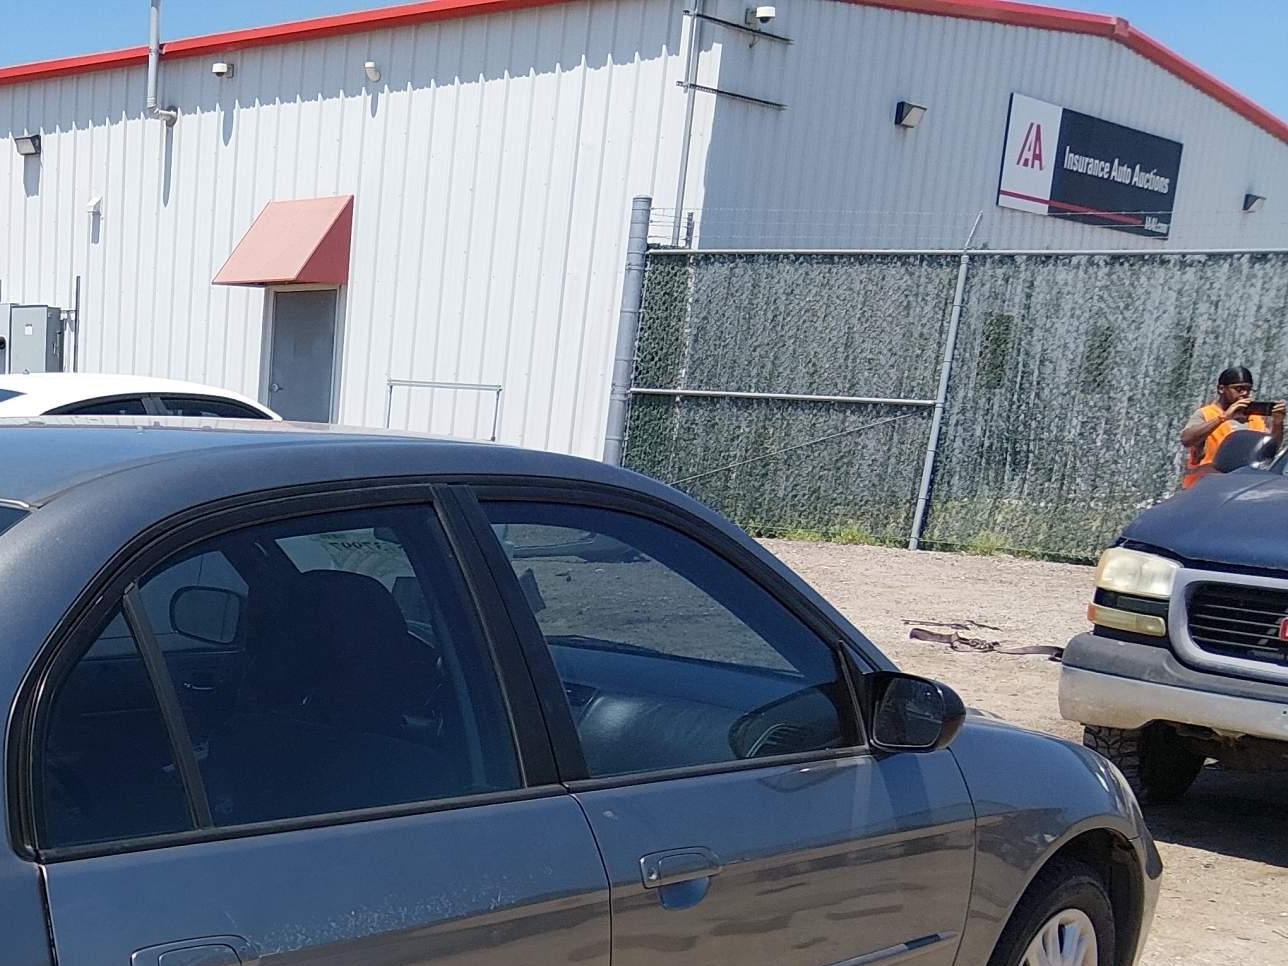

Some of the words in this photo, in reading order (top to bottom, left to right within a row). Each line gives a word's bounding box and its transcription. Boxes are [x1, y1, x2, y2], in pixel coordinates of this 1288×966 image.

[1064, 145, 1111, 179] Insurance
[1110, 158, 1133, 185] Auto
[1131, 163, 1171, 194] Auctions
